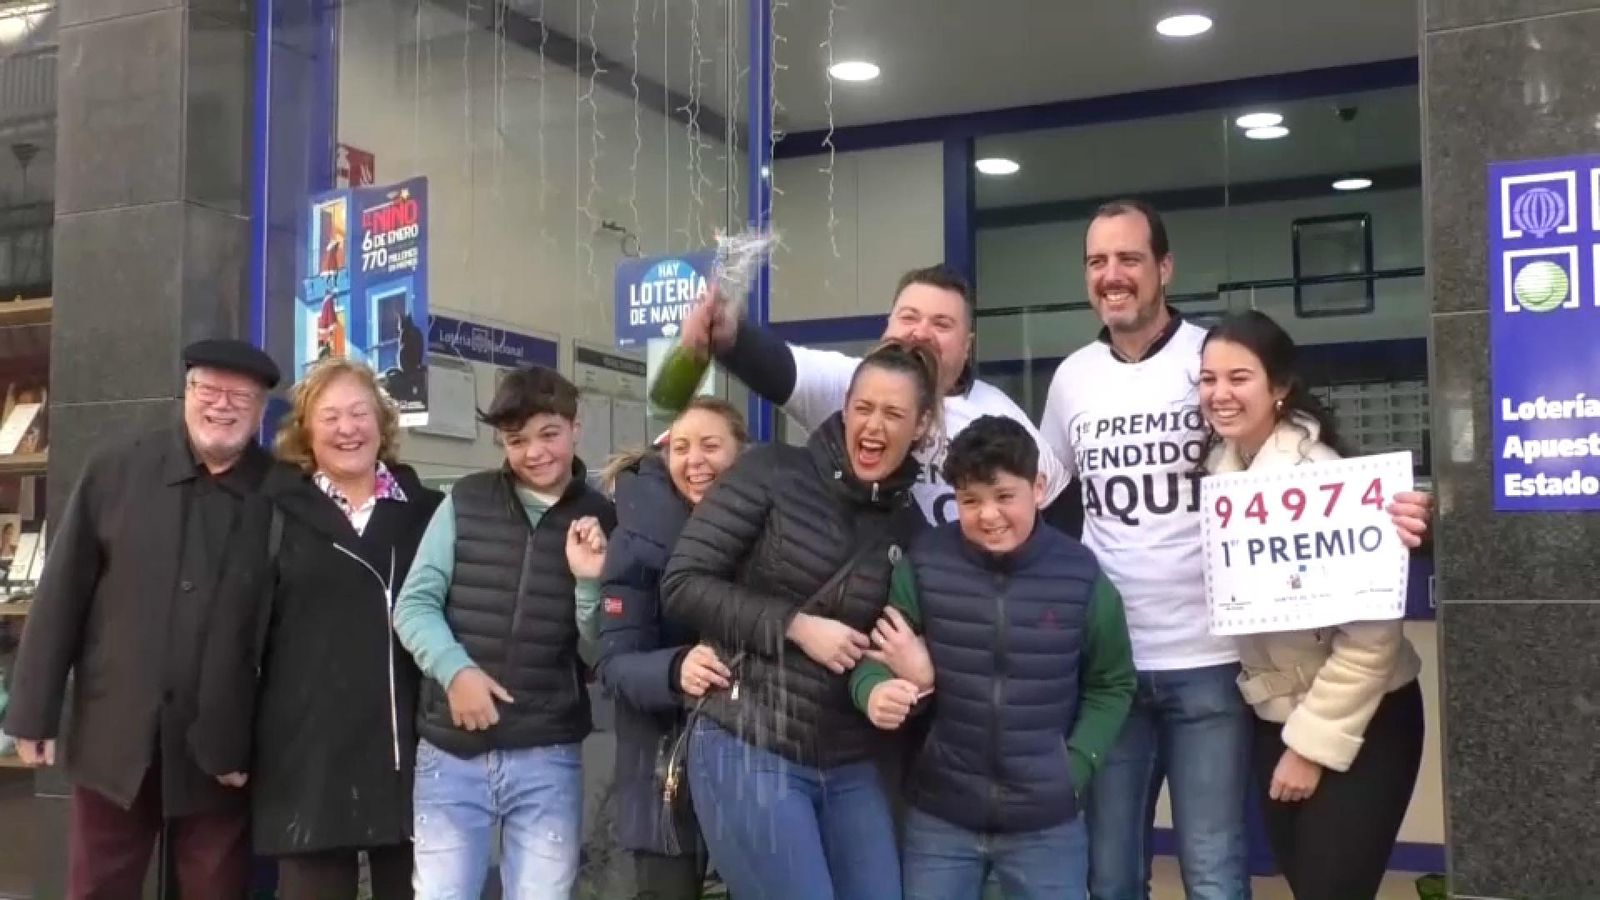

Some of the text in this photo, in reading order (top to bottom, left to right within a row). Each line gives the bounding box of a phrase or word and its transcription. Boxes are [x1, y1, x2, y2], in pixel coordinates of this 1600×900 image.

[362, 223, 418, 251] 6 DE ENERO
[362, 247, 387, 272] 770
[657, 262, 680, 278] HAY
[630, 269, 708, 306] LOTERÍA
[630, 308, 647, 326] DE
[1502, 392, 1600, 421] Lotería
[1095, 409, 1205, 439] PREMIO
[1078, 440, 1203, 472] VENDIDO
[1504, 469, 1600, 497] Estado
[1214, 477, 1385, 529] 94974
[1247, 525, 1383, 566] PREMIO
